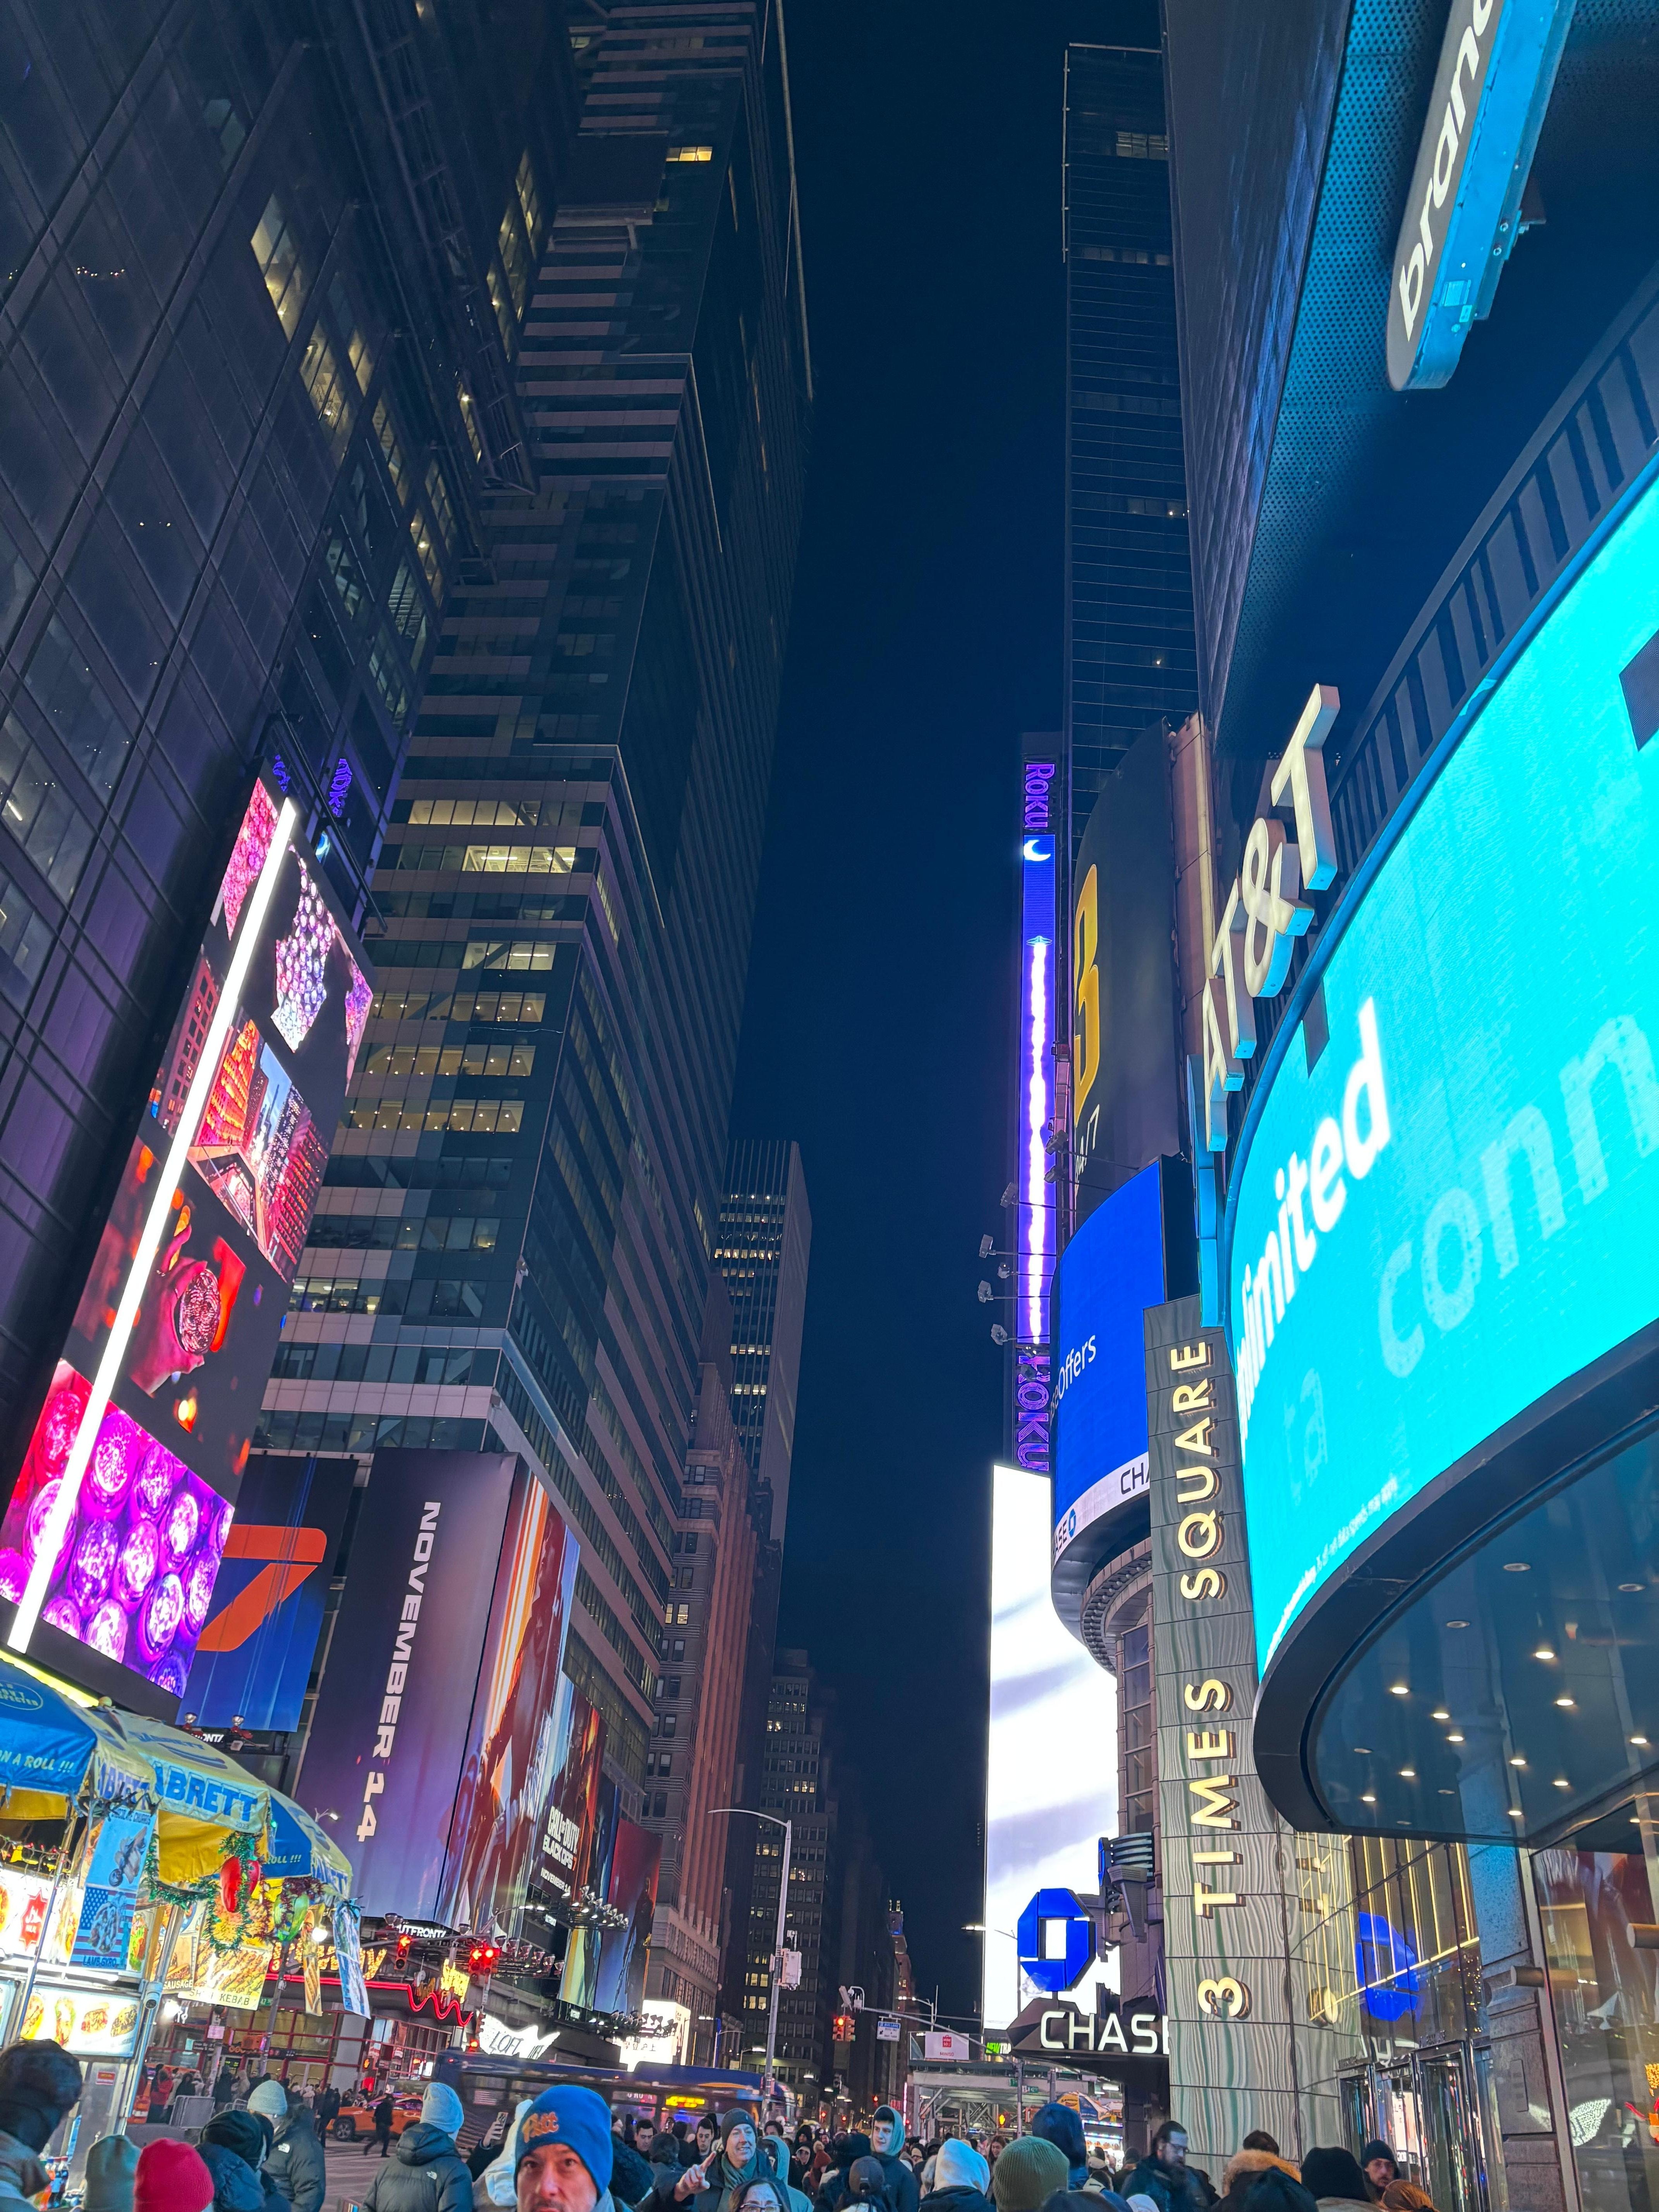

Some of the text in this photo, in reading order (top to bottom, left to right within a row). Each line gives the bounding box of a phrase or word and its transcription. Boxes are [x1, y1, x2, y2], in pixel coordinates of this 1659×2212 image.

[1203, 683, 1321, 1152] AT&T
[1053, 1520, 1067, 1557] ASE
[357, 1502, 441, 1842] NOVEMBER 14
[1171, 1342, 1243, 2017] 3 TIMES SQUARE
[12, 1753, 21, 1765] A
[24, 1755, 55, 1771] ROLL
[548, 1806, 563, 1842] CALL
[543, 1834, 577, 1871] BLACK OPS 7
[541, 1867, 565, 1891] NOVEMBER
[163, 1979, 193, 1990] SAUSAGE
